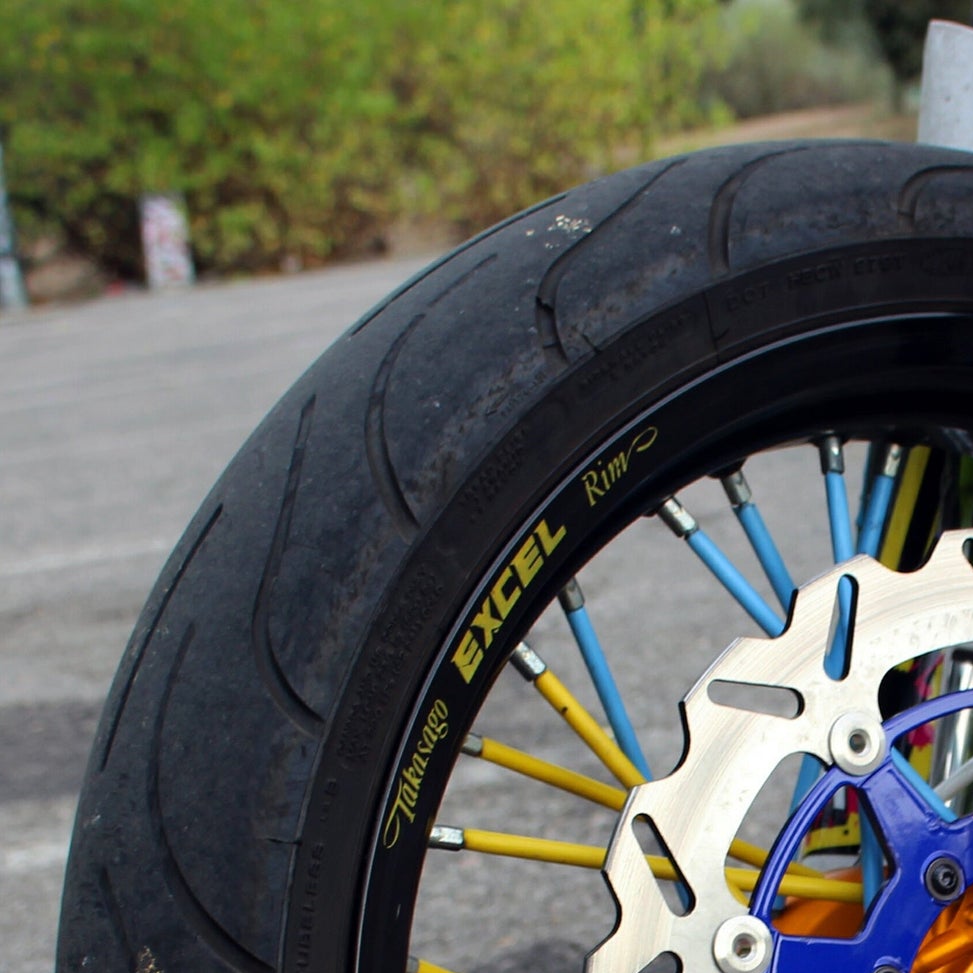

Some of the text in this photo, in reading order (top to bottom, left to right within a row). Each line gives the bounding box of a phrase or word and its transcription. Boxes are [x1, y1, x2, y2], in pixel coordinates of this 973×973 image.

[383, 700, 449, 849] Takasago
[450, 518, 567, 685] EXCEL
[582, 426, 658, 506] Rim
